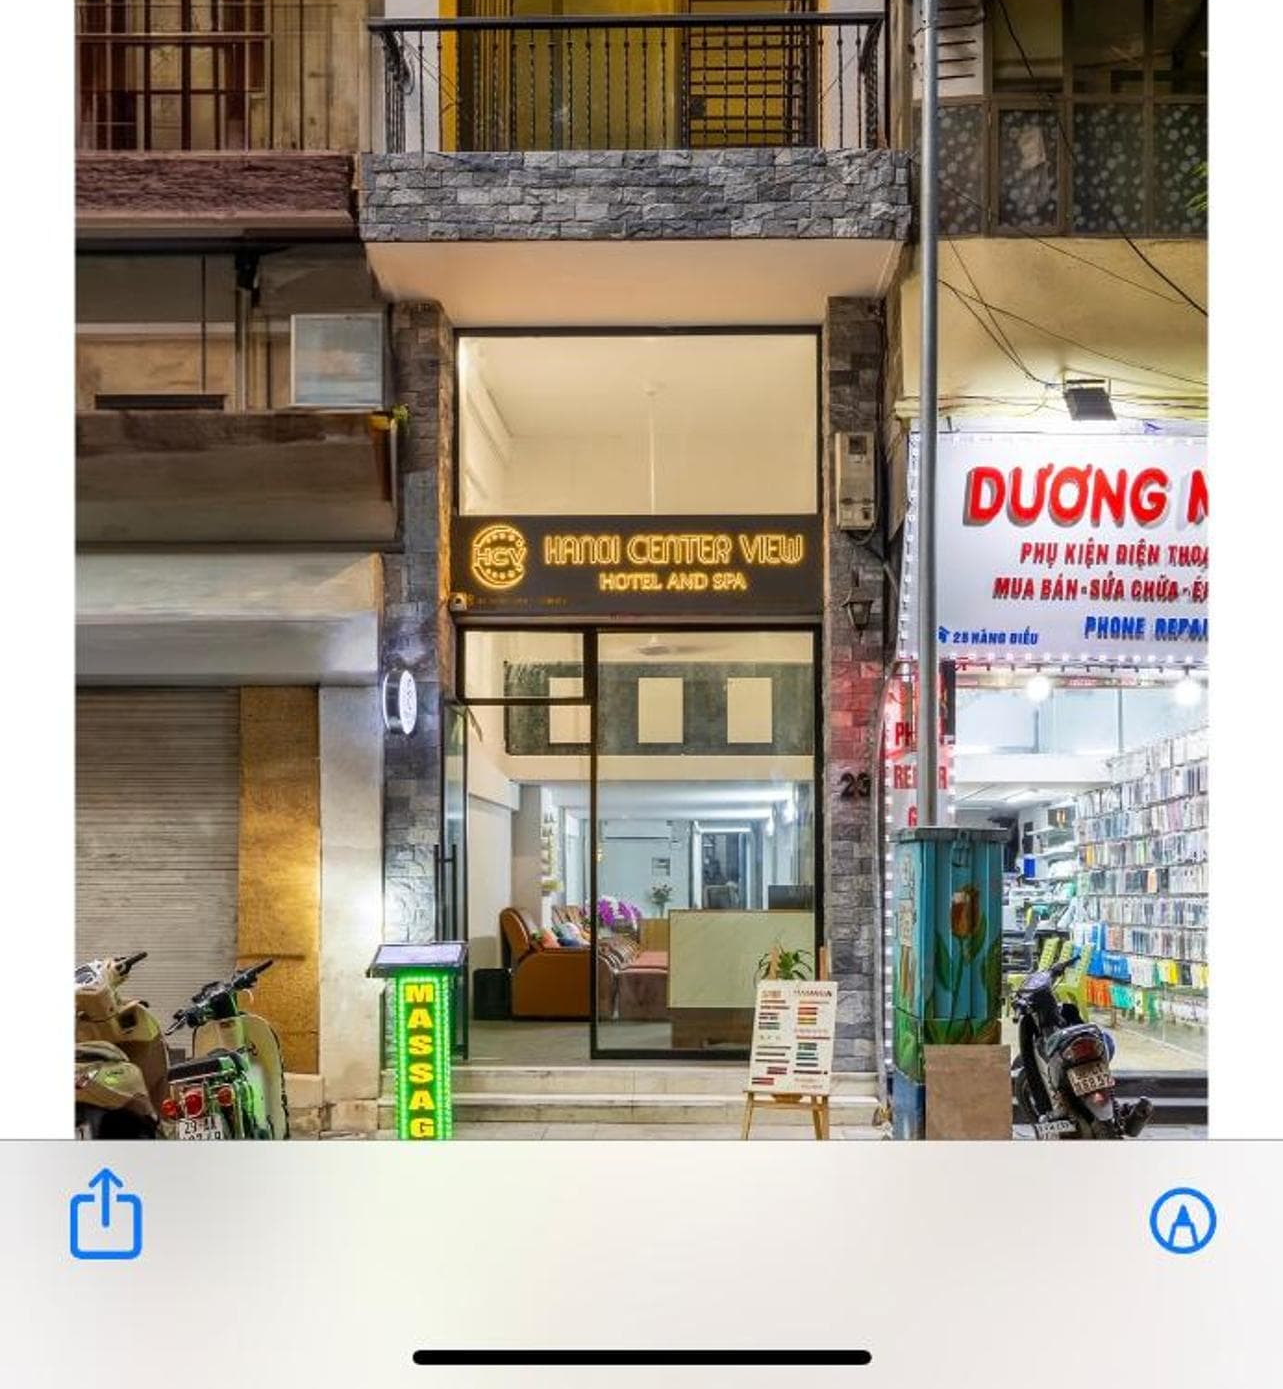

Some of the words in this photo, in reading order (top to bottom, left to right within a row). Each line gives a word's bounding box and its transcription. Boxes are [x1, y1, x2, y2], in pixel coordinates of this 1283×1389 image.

[964, 464, 1169, 526] DƯƠNG
[544, 534, 621, 565] HANOI
[626, 534, 733, 564] CENTER
[738, 534, 804, 564] VIEW
[1020, 542, 1058, 568] PHỤ
[599, 572, 663, 591] HOTEL
[666, 572, 709, 591] AND
[712, 572, 748, 591] SPA
[992, 577, 1035, 600] MUA
[1084, 615, 1146, 640] PHONE
[404, 982, 435, 1139] MASSAG
